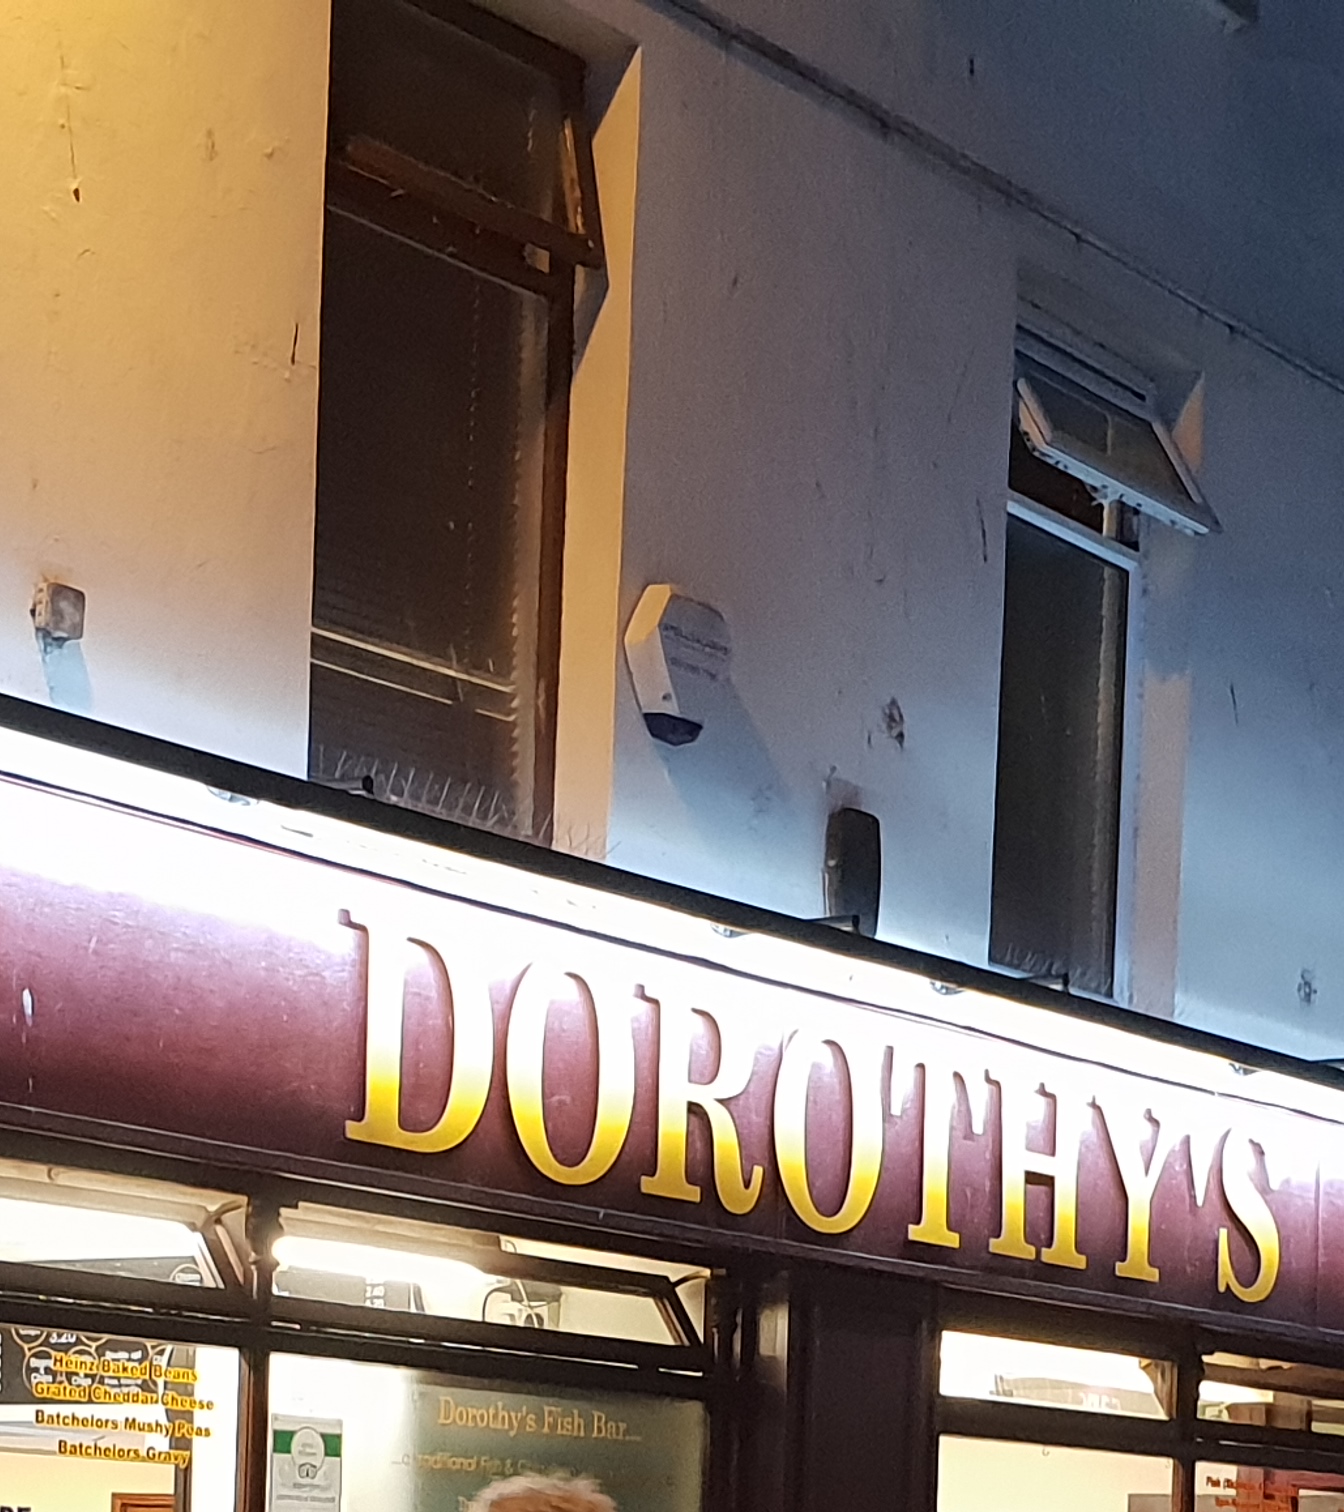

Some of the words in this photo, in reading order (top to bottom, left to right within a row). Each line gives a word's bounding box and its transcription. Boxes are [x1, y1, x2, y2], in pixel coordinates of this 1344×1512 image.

[336, 908, 1282, 1305] DOROTHY'S
[52, 1353, 97, 1373] Heinz
[102, 1357, 148, 1378] Baked
[153, 1361, 198, 1383] Beans
[34, 1381, 87, 1400] Grated
[92, 1385, 158, 1405] Cheddar
[160, 1390, 214, 1411] Cheese
[34, 1409, 119, 1430] Batchelors
[123, 1416, 172, 1438] Mushy
[174, 1420, 211, 1438] Peas
[437, 1395, 538, 1438] Dorothy's
[542, 1404, 585, 1438] Fish
[57, 1439, 141, 1460] Batchelors
[145, 1446, 191, 1467] Gravy
